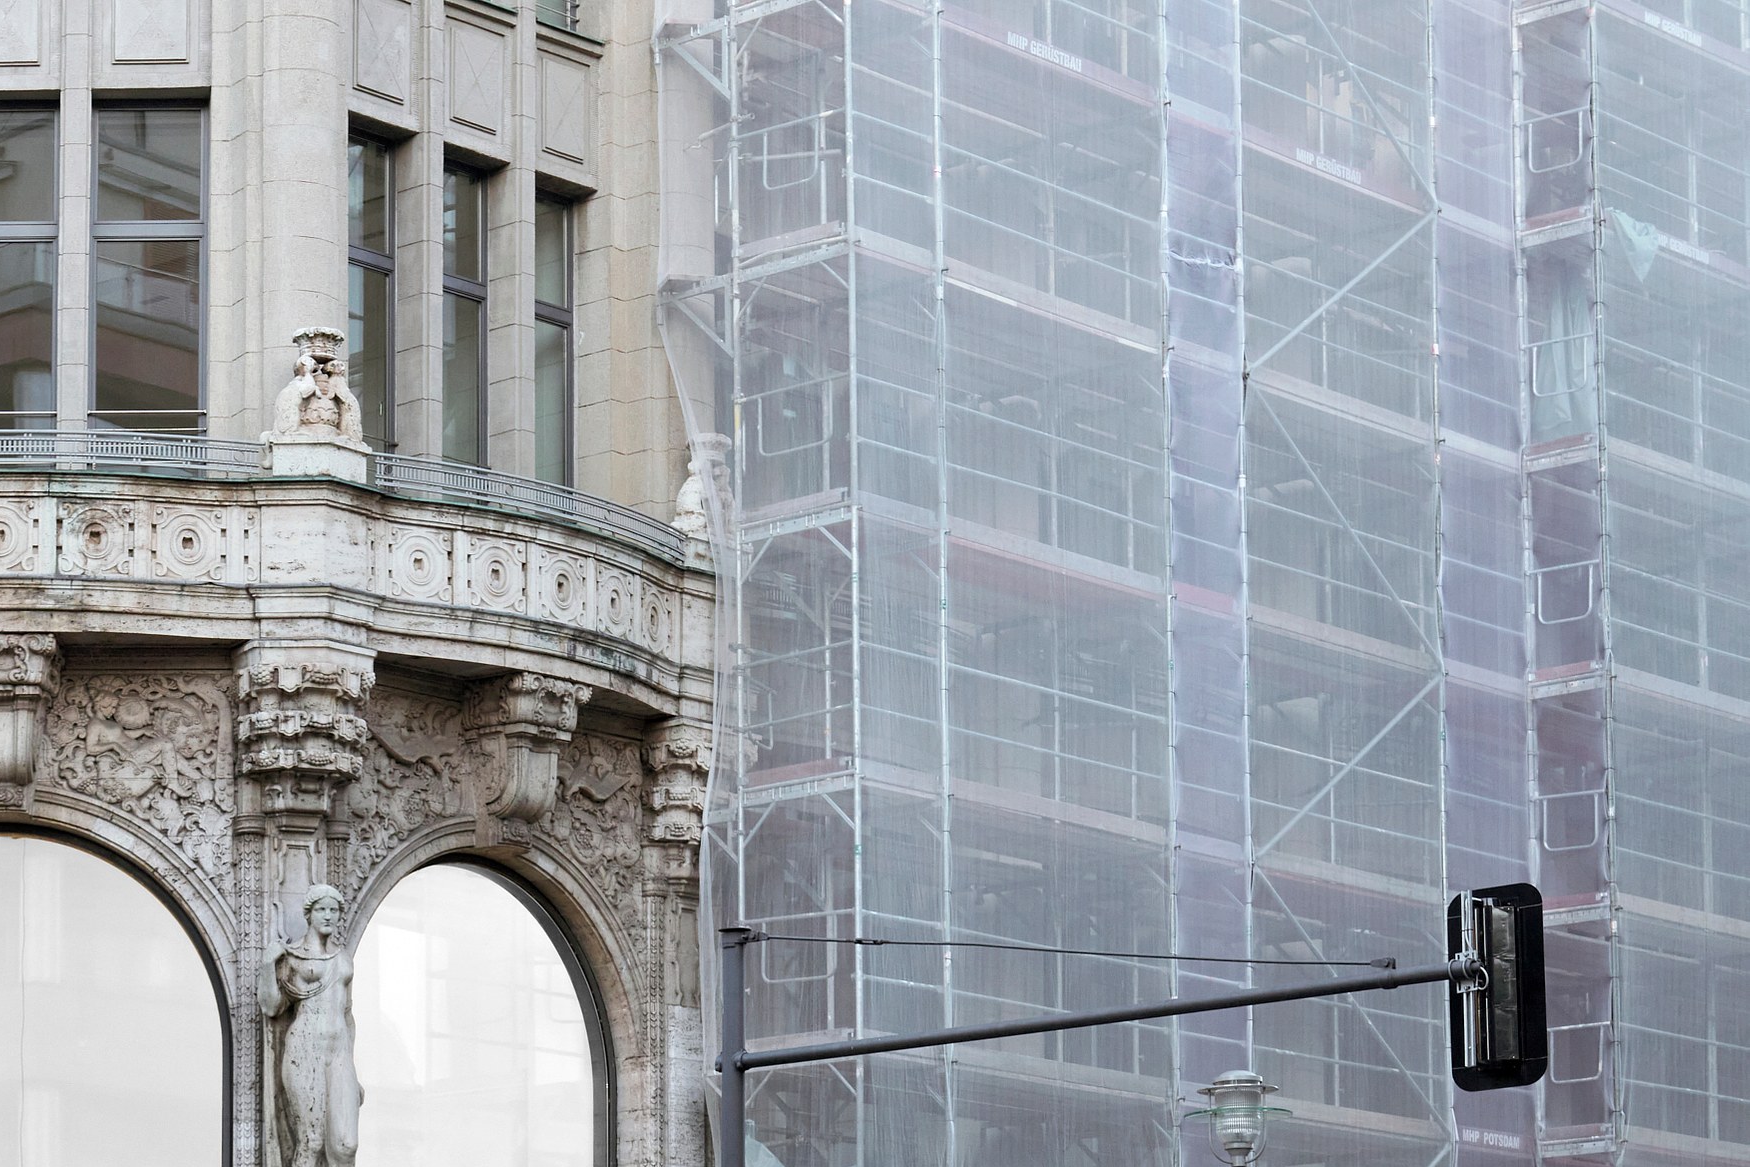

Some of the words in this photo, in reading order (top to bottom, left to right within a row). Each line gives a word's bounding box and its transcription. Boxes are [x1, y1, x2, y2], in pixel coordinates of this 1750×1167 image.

[1007, 31, 1028, 50] MHP
[1030, 40, 1081, 72] GERÜSTBAU
[1462, 1129, 1480, 1143] MHP
[1483, 1132, 1520, 1149] POTSDAM
